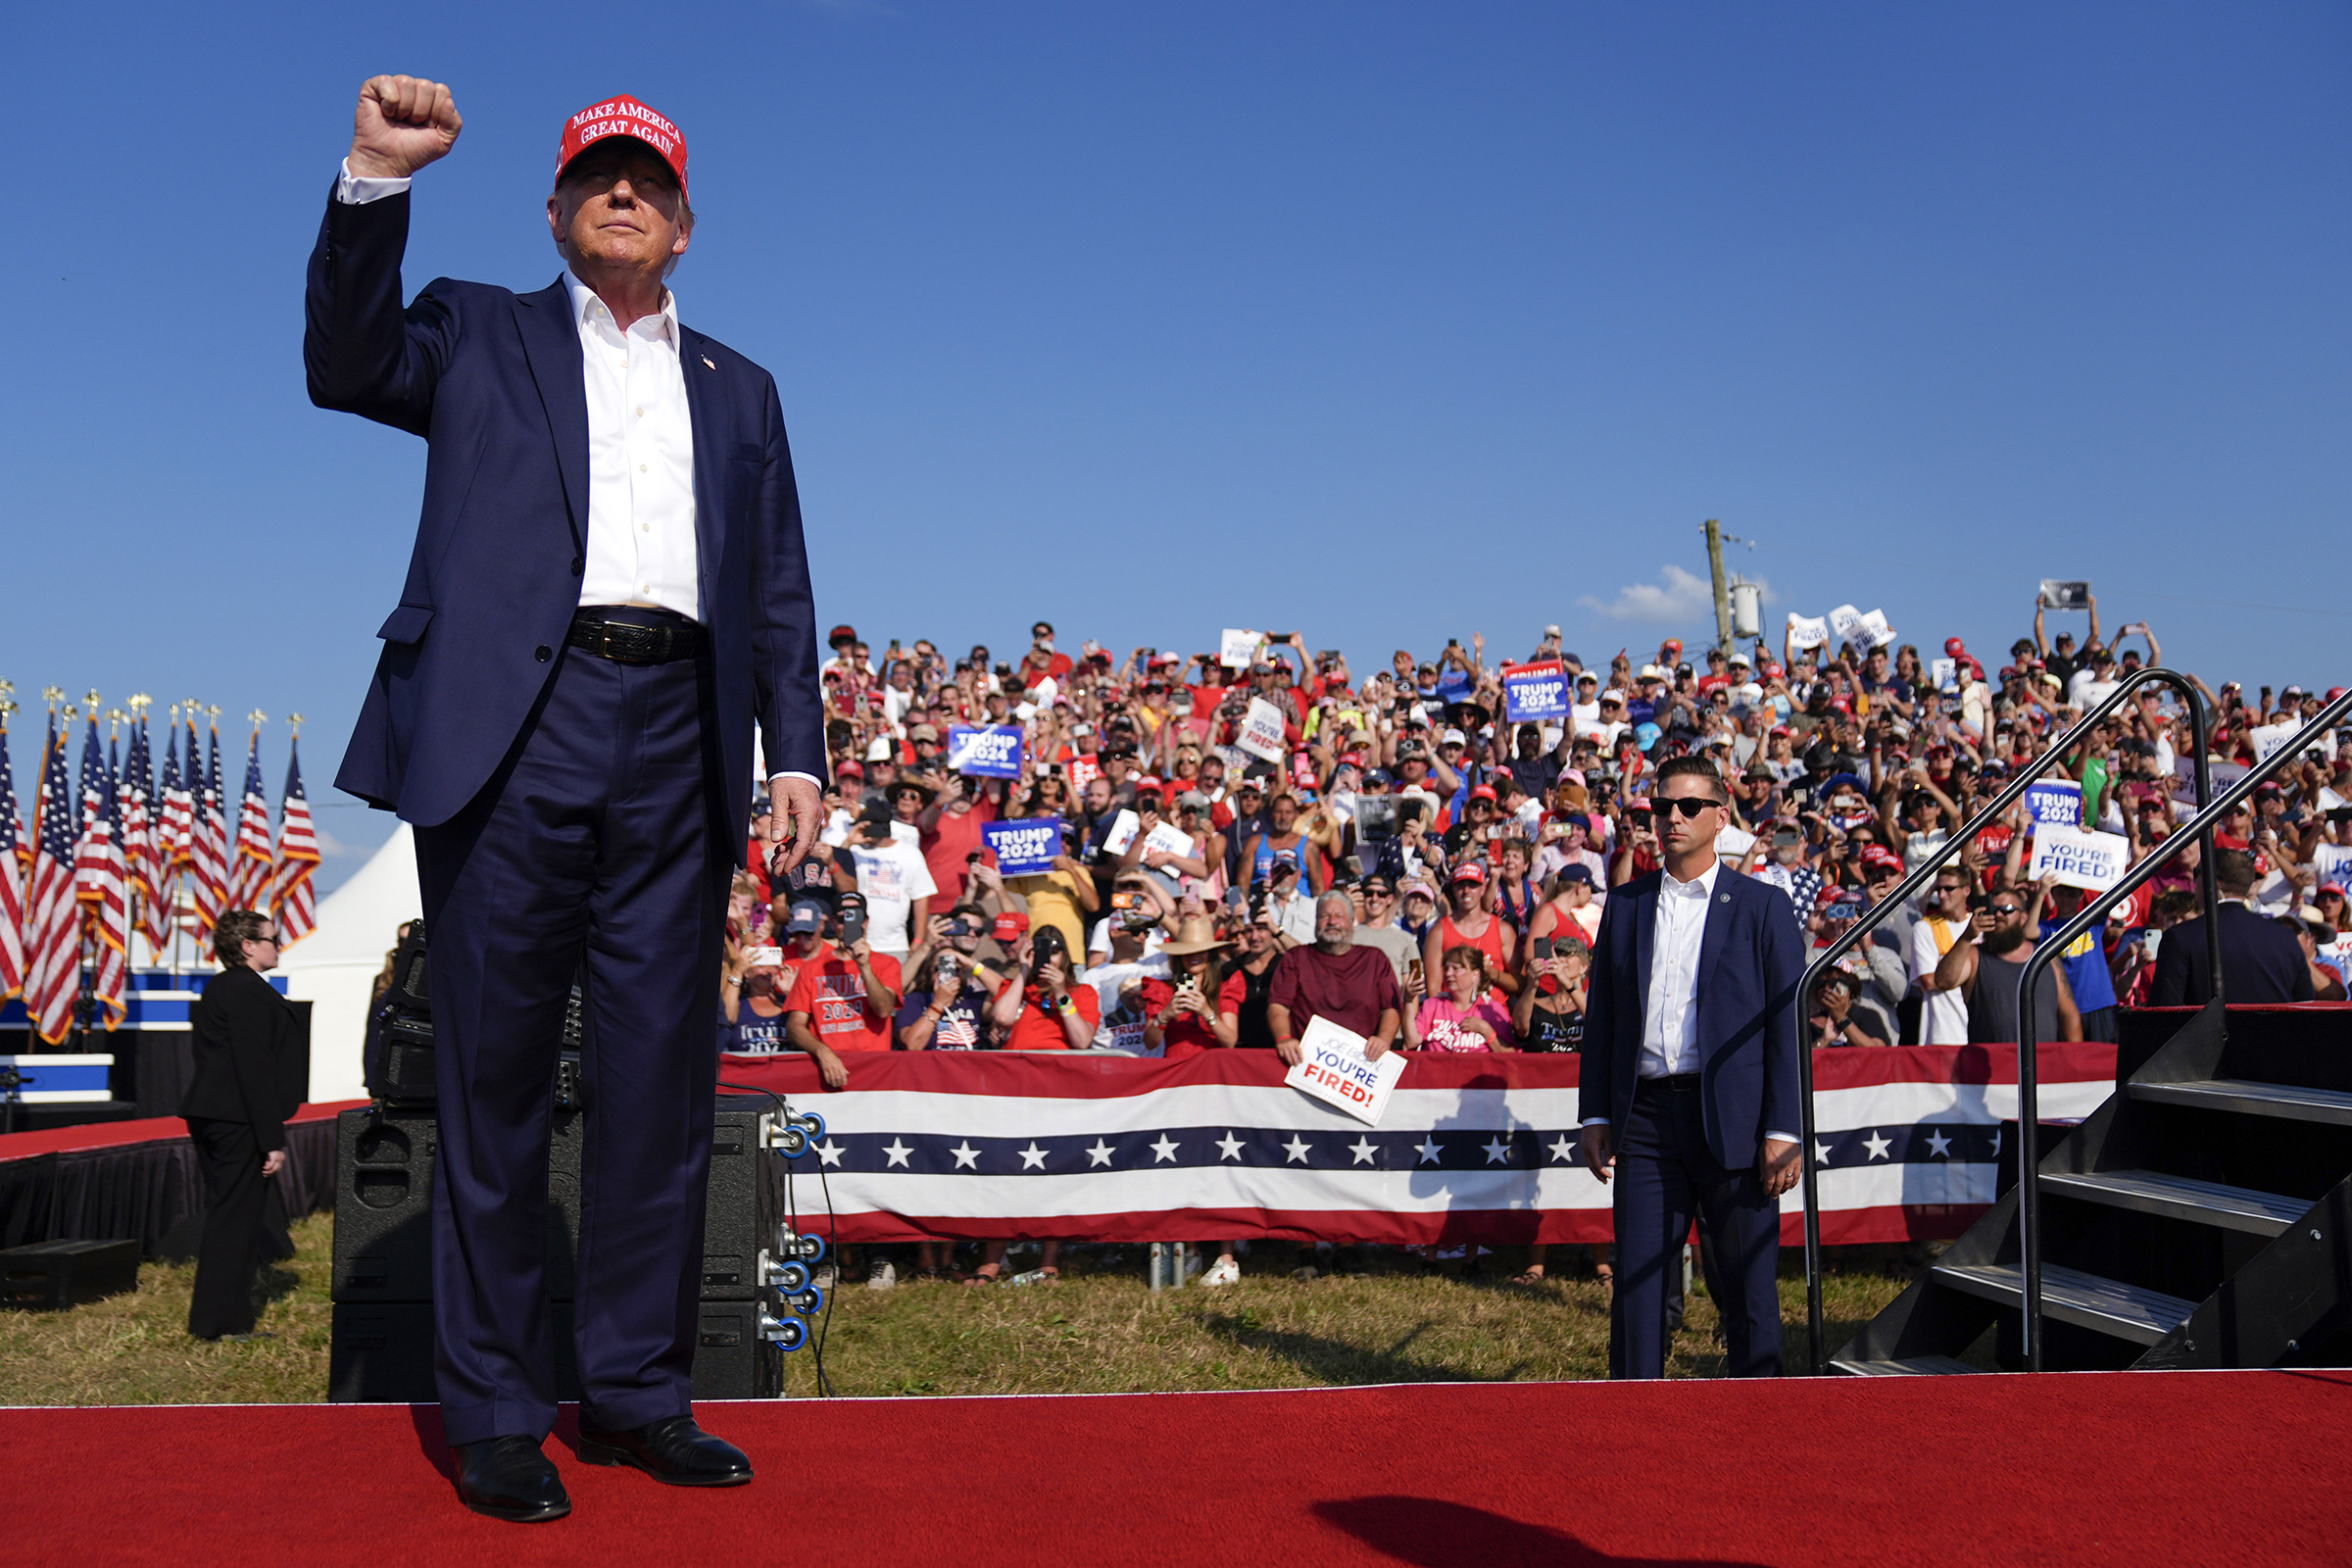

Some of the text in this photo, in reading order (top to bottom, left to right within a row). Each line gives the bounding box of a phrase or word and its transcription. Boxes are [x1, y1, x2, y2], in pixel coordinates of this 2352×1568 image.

[572, 102, 682, 145] MAKE AMERICA
[580, 121, 674, 158] GREAT AGAIN
[1510, 681, 1563, 699] TRUMP
[1519, 693, 1557, 709] 2024
[965, 745, 1008, 762] 024
[2031, 792, 2080, 809] TRUMP
[2039, 806, 2076, 823] 2024
[988, 827, 1054, 847] TRUMP
[998, 841, 1047, 859] 2024
[2050, 844, 2115, 863] YOU'RE
[789, 863, 832, 891] USA
[2039, 856, 2118, 881] FIRED!
[815, 973, 864, 998] TRUM
[822, 1000, 863, 1021] 2024
[1110, 1024, 1146, 1037] TRUM
[1118, 1035, 1142, 1047] 202
[1322, 1037, 1349, 1051] JOE
[1316, 1046, 1378, 1089] YOU'RE
[1303, 1063, 1374, 1108] FIRED!
